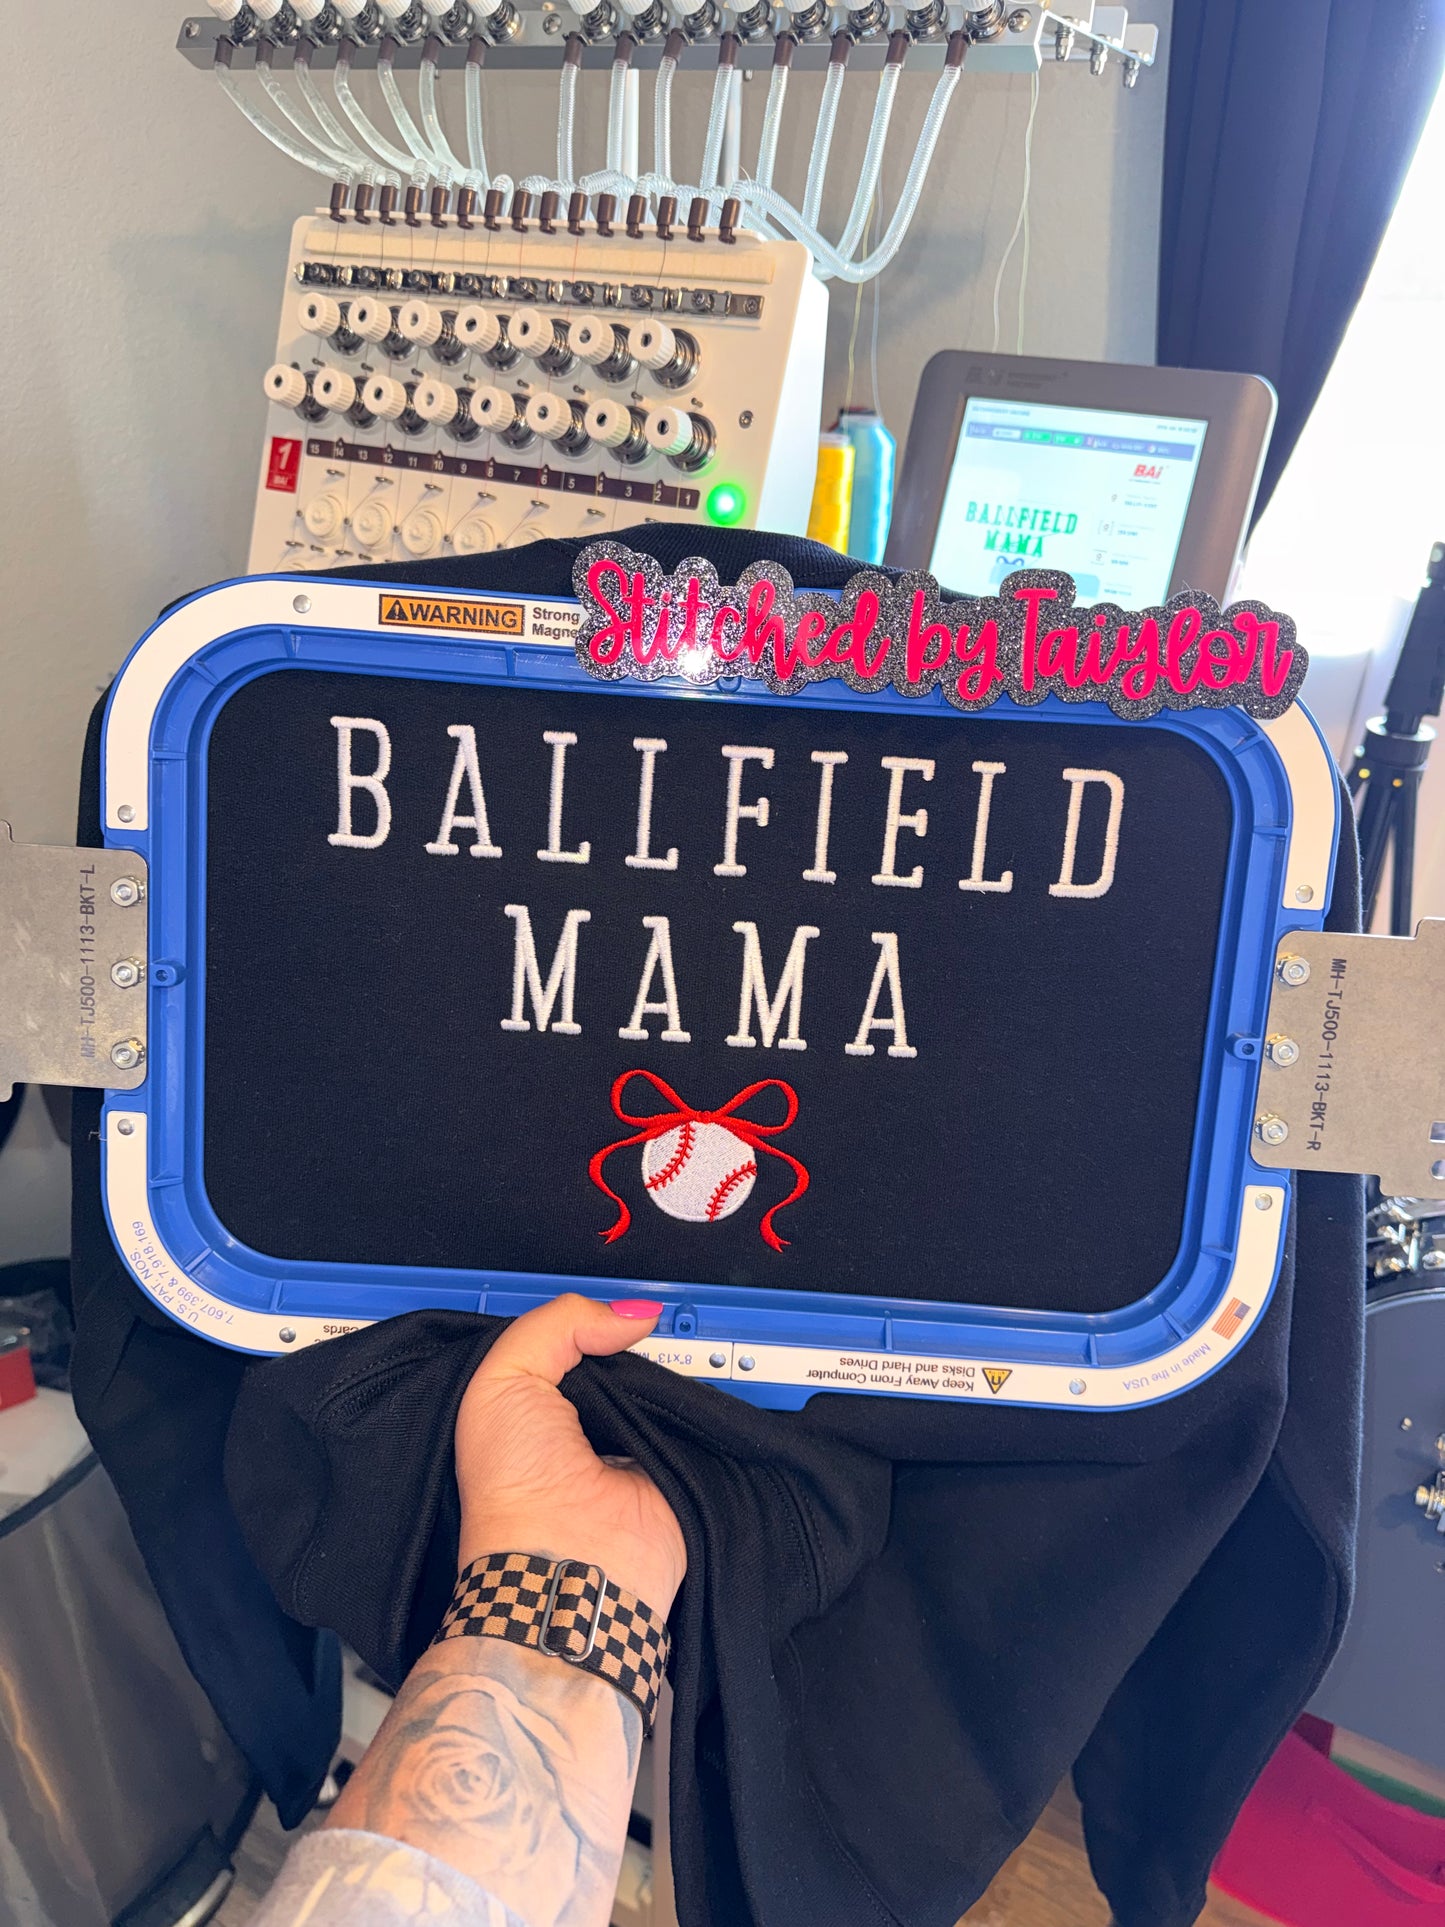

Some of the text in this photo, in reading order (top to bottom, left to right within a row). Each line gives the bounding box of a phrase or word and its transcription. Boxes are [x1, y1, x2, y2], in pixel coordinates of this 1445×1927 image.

[278, 441, 293, 470] 1
[310, 444, 691, 505] 15 14 13 12 11 10 9 8 7 6 5 4 3 2 1
[965, 501, 1078, 534] BALLFIELD
[984, 530, 1043, 558] MAMA
[409, 603, 517, 628] WARNING
[532, 606, 580, 625] Strong
[587, 559, 1293, 700] Stitched by Taiylor
[532, 623, 578, 640] Magne
[327, 715, 1126, 900] BALLFIELD
[80, 864, 96, 1058] MH-TJ500-1113-BKT-L
[500, 904, 918, 1058] MAMA
[1306, 958, 1347, 1151] MH-TJ500-1113-BKT-R
[151, 1279, 175, 1304] PAT.
[168, 1276, 179, 1288] &
[176, 1301, 200, 1323] U.S.
[806, 1368, 975, 1392] Keep Away From Computer
[839, 1357, 976, 1378] Disks and Hard Drives
[1122, 1343, 1212, 1391] Made in the USA
